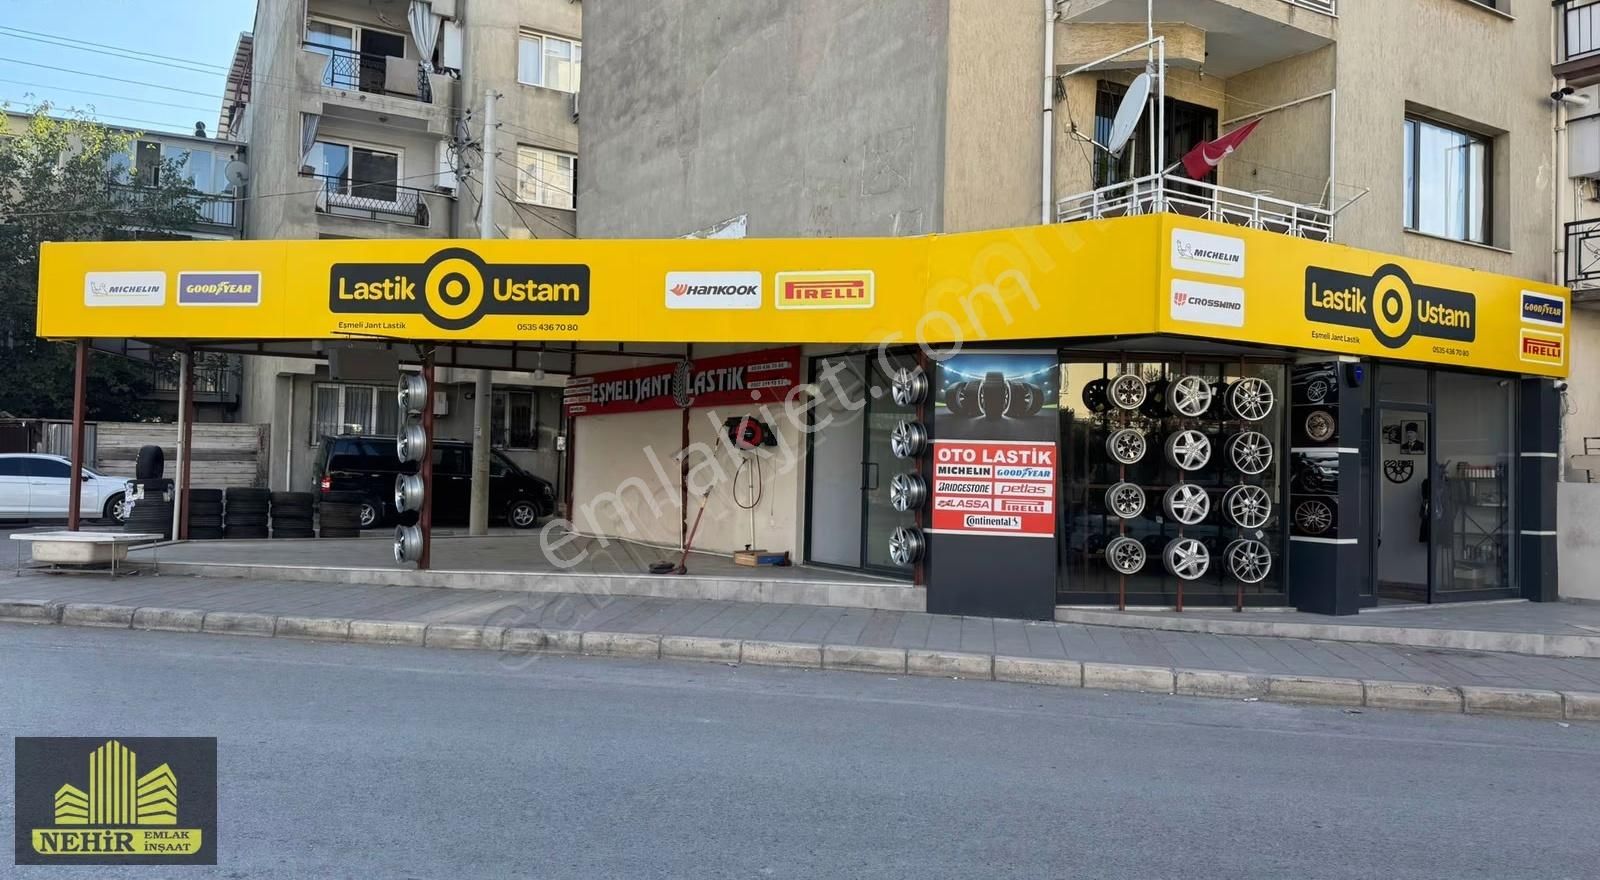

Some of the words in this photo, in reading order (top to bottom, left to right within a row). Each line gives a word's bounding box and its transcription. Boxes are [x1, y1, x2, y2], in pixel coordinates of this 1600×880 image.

[1194, 248, 1240, 263] MICHELIN
[109, 285, 160, 293] MICHELIN
[186, 281, 252, 295] GOODYEAR
[338, 275, 416, 301] Lastik
[493, 277, 580, 302] Ustam
[785, 280, 864, 300] PIRELLI
[1188, 296, 1242, 310] CROSSWIND
[1311, 281, 1367, 315] Lastik
[1417, 299, 1470, 329] Ustam
[1524, 303, 1562, 316] GOODYEAR
[517, 323, 538, 331] 0535
[1522, 336, 1561, 358] PIRELLI
[634, 374, 671, 404] JANT
[938, 448, 976, 463] OTO
[982, 447, 1052, 465] LASTİK
[938, 466, 991, 476] MICHELIN
[997, 467, 1050, 478] GOODYEAR
[938, 482, 989, 493] BRIDGESTONE
[1000, 484, 1046, 494] petlas
[951, 500, 989, 509] LASSA
[1001, 500, 1044, 512] PIRELLI
[966, 515, 1011, 527] Continental
